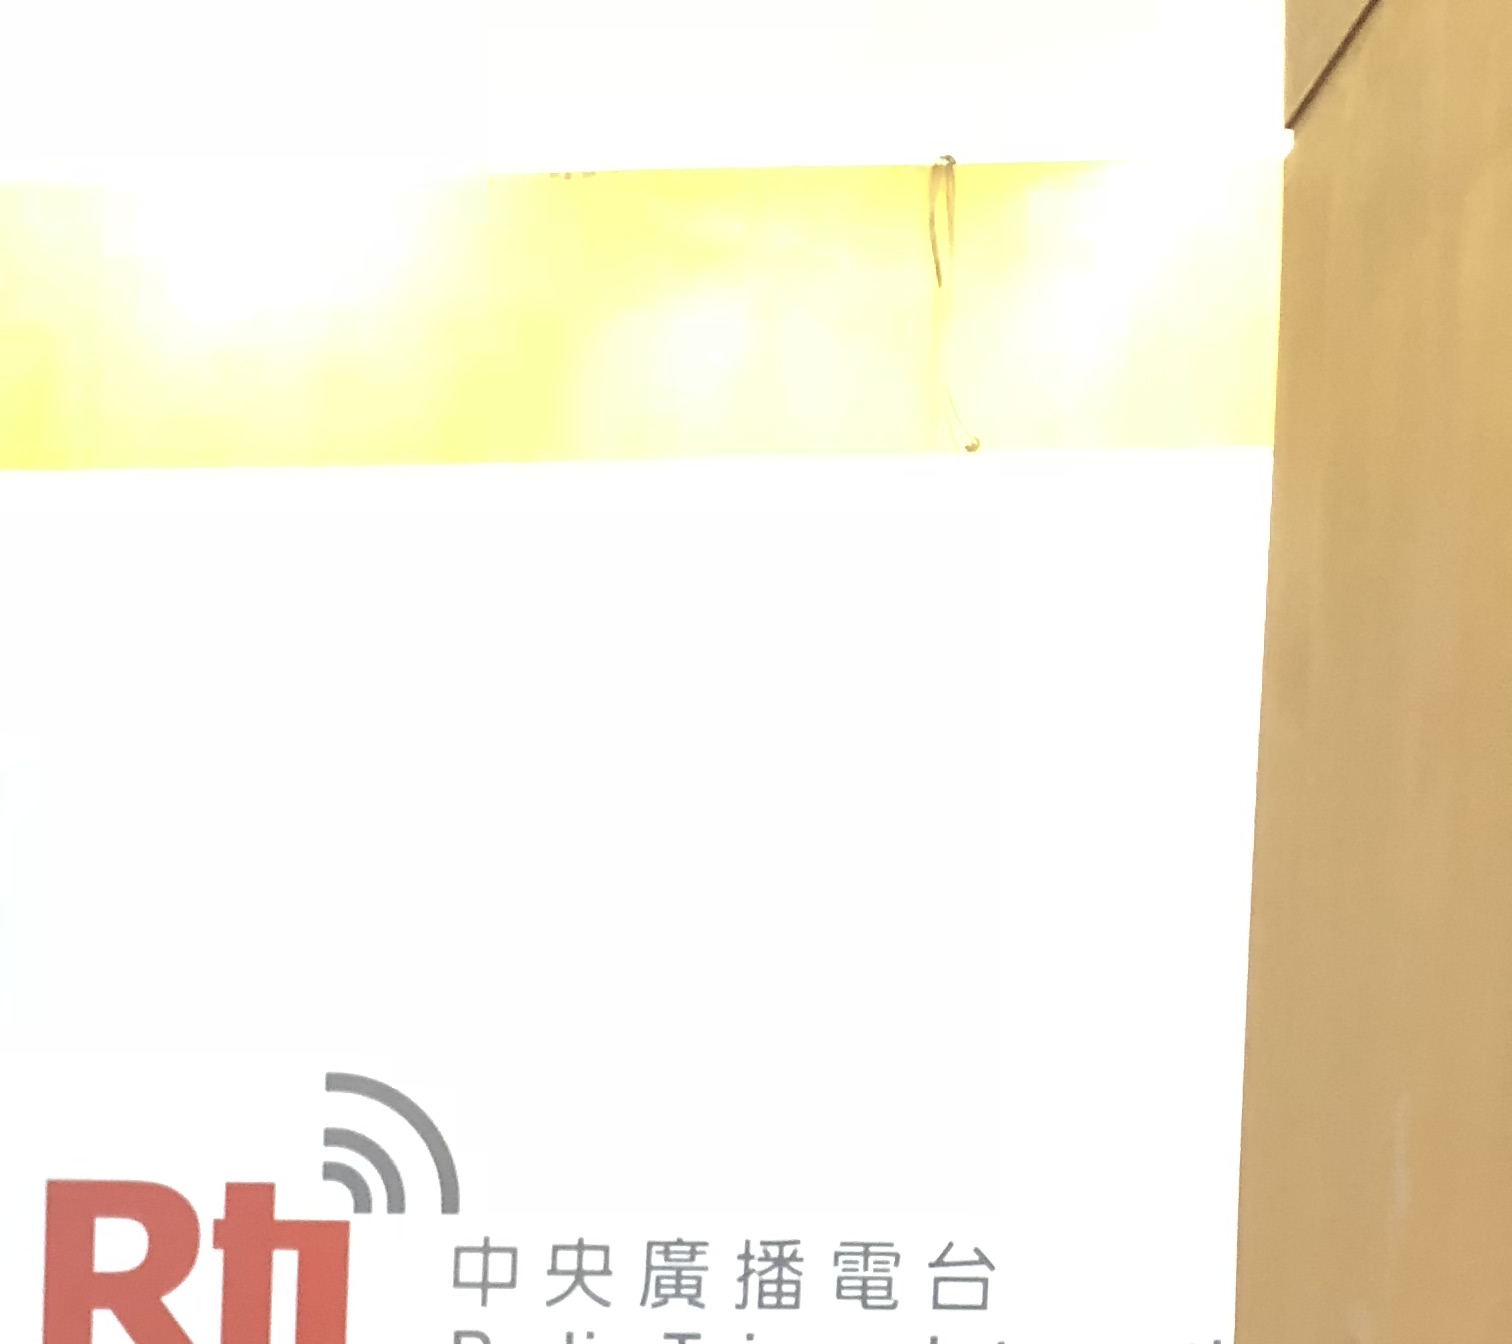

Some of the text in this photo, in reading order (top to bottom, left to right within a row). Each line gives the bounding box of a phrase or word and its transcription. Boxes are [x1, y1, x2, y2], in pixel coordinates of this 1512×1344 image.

[452, 1236, 996, 1311] 中央廣播電台
